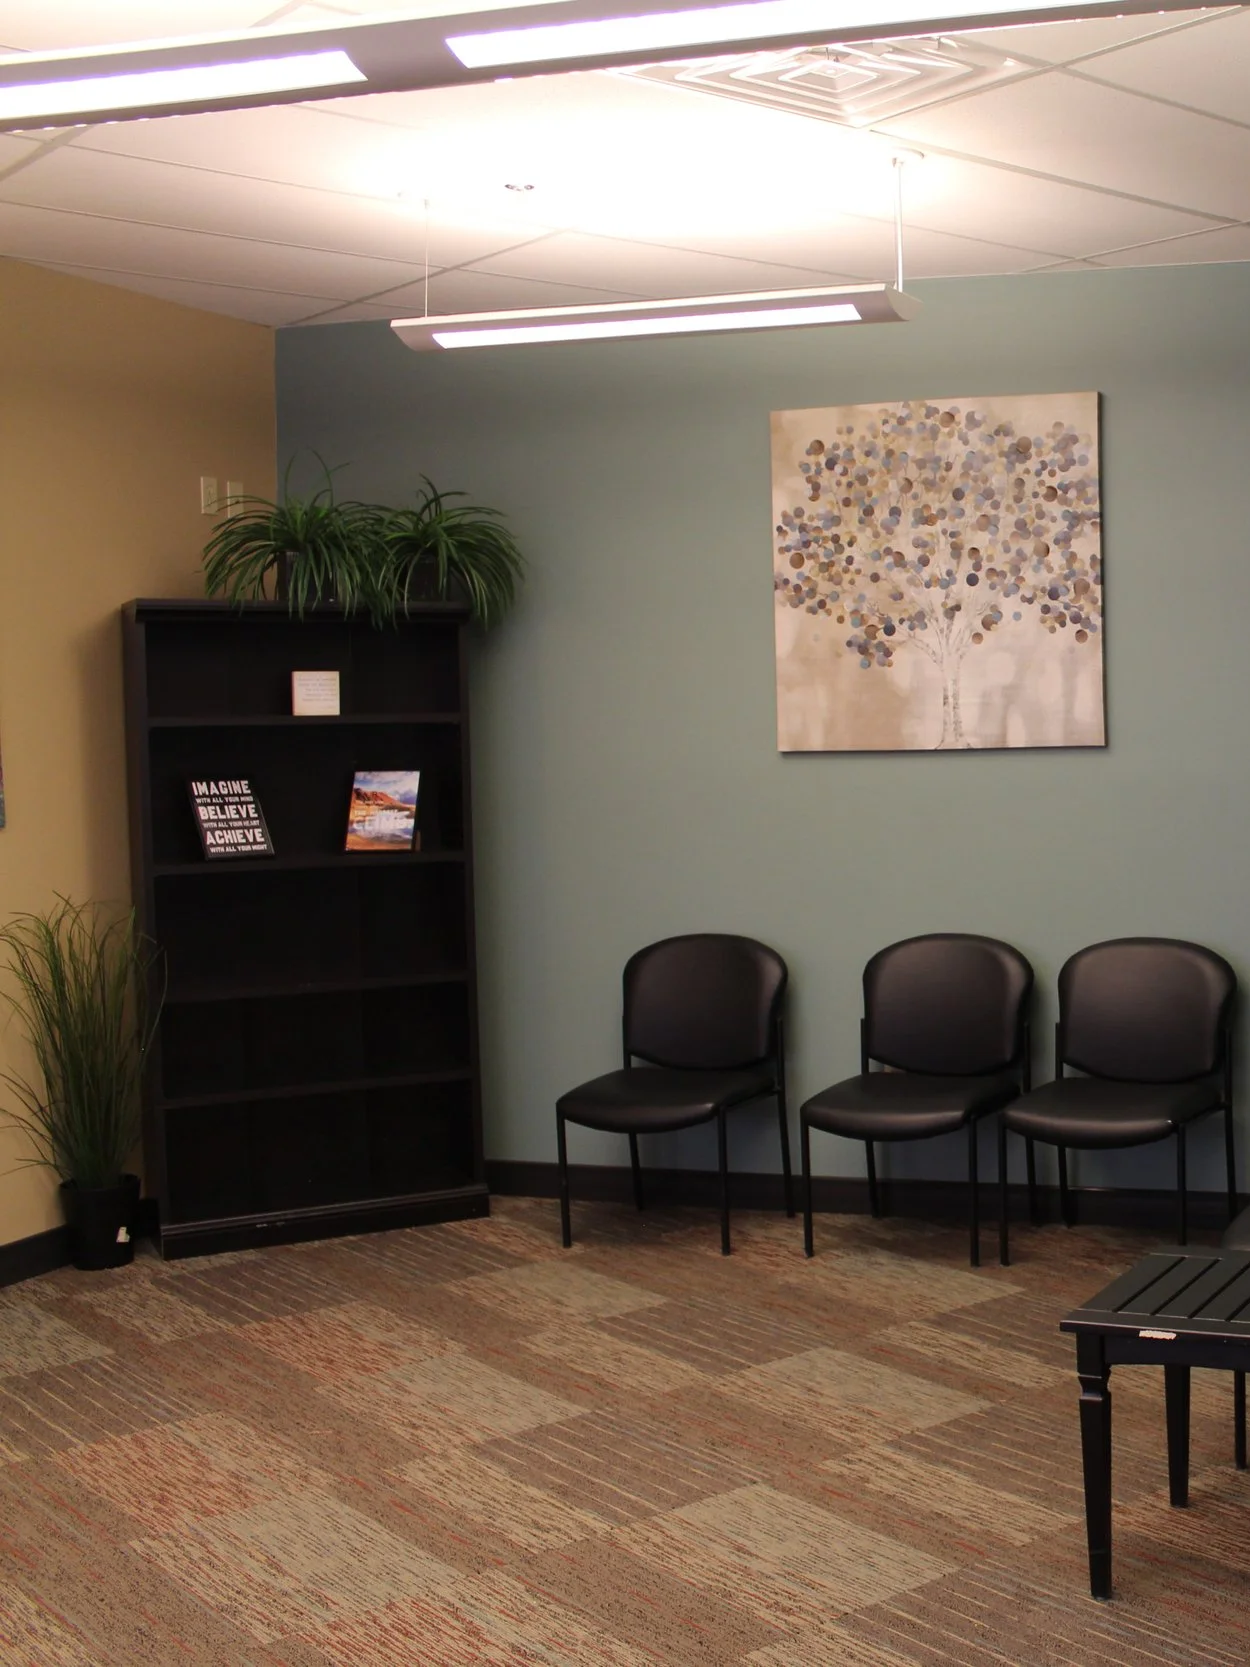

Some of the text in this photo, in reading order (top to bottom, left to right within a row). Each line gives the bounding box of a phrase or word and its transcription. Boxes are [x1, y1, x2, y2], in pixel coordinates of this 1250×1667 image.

[192, 780, 251, 796] IMAGINE
[198, 804, 258, 820] BELIEVE
[206, 828, 265, 845] ACHIEVE
